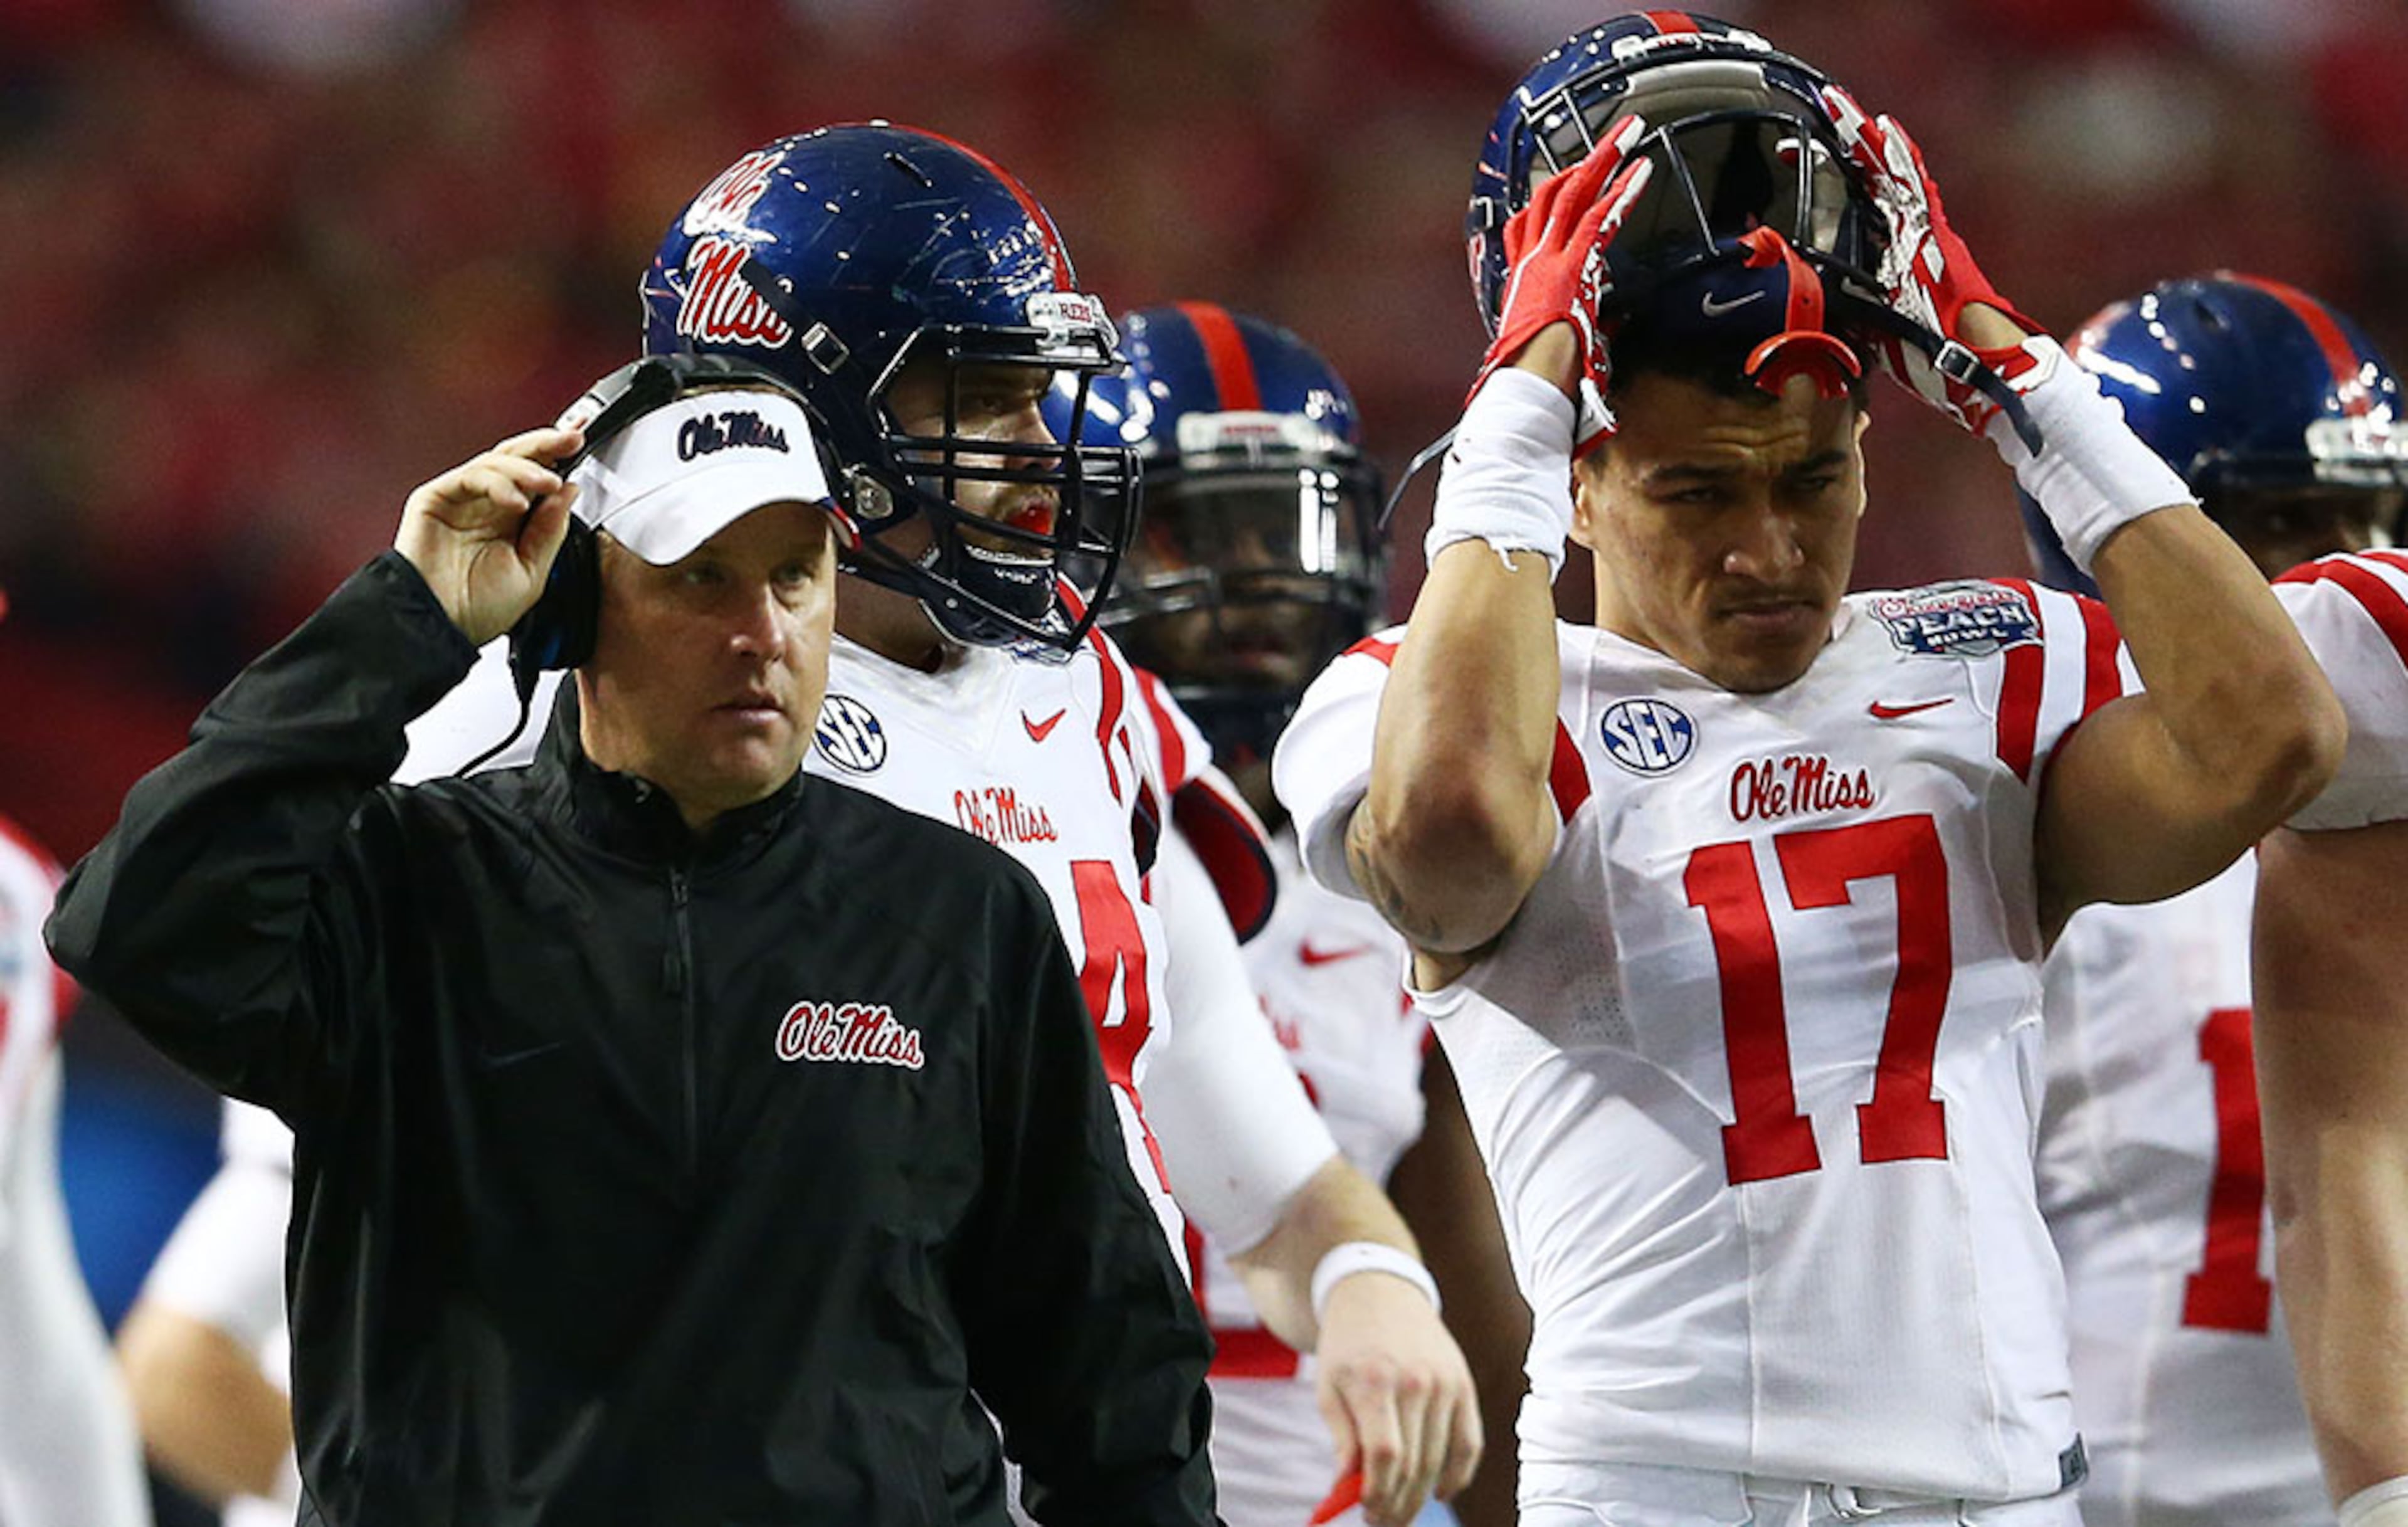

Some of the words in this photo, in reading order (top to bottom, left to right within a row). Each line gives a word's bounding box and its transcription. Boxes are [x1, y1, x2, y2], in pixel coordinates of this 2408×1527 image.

[677, 236, 793, 349] Miss
[678, 413, 726, 461] Ole
[719, 411, 789, 453] Miss
[1891, 602, 2027, 644] PEACH
[1926, 626, 2009, 647] BOWL
[815, 696, 886, 771] SEC
[1602, 700, 1691, 771] SEC
[954, 789, 998, 846] Ole
[985, 787, 1058, 843] Miss
[1731, 759, 1787, 822] Ole
[1782, 756, 1875, 815] Miss
[1682, 813, 1953, 1186] 17
[775, 1001, 841, 1062] Ole
[835, 1001, 924, 1070] Miss
[2180, 1008, 2273, 1337] 1
